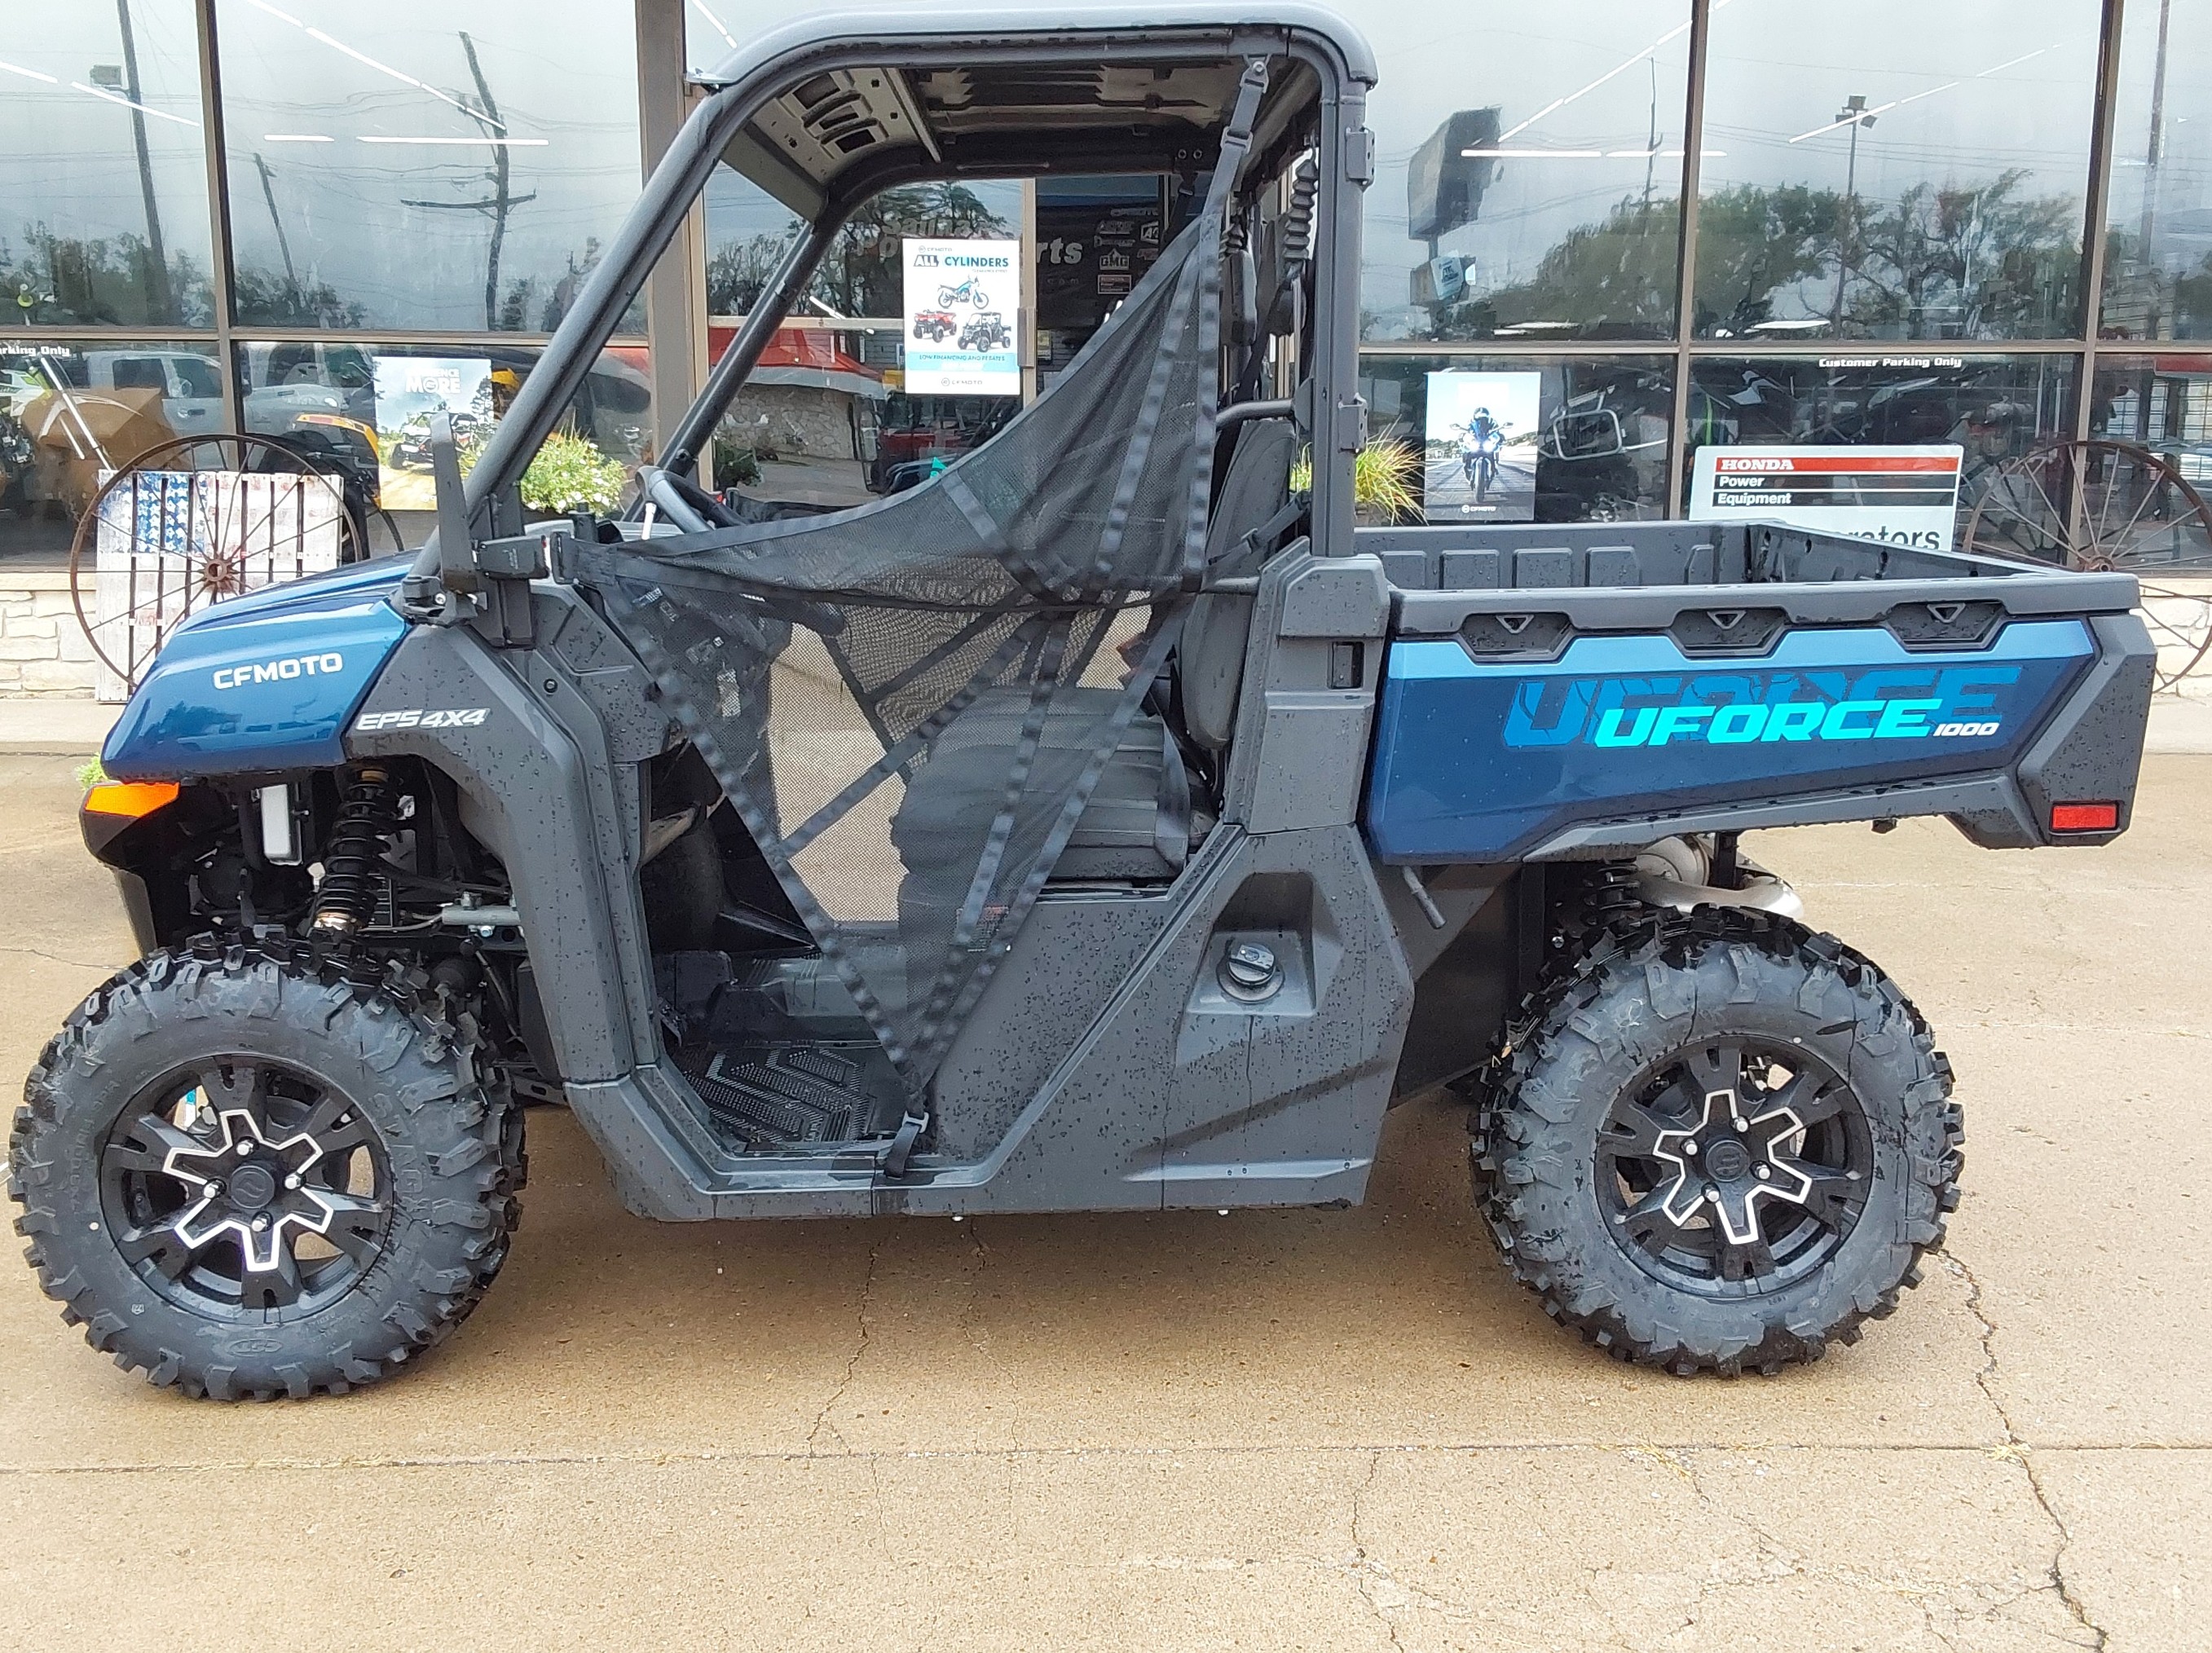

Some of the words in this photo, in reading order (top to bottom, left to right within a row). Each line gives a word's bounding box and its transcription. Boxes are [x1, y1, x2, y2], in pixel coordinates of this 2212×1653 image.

[913, 254, 940, 267] ALL
[944, 256, 1010, 267] CYLINDERS
[40, 346, 70, 357] Only
[1818, 358, 1879, 368] Customer
[1882, 358, 1930, 368] Parking
[1934, 357, 1963, 368] Only
[405, 377, 461, 394] MORE
[1721, 459, 1795, 471] HONDA
[1719, 476, 1765, 488] Power
[1716, 492, 1791, 508] Equipment
[213, 652, 343, 690] CFMOTO
[1594, 699, 1941, 748] UFORCE
[1932, 722, 2000, 737] 1000
